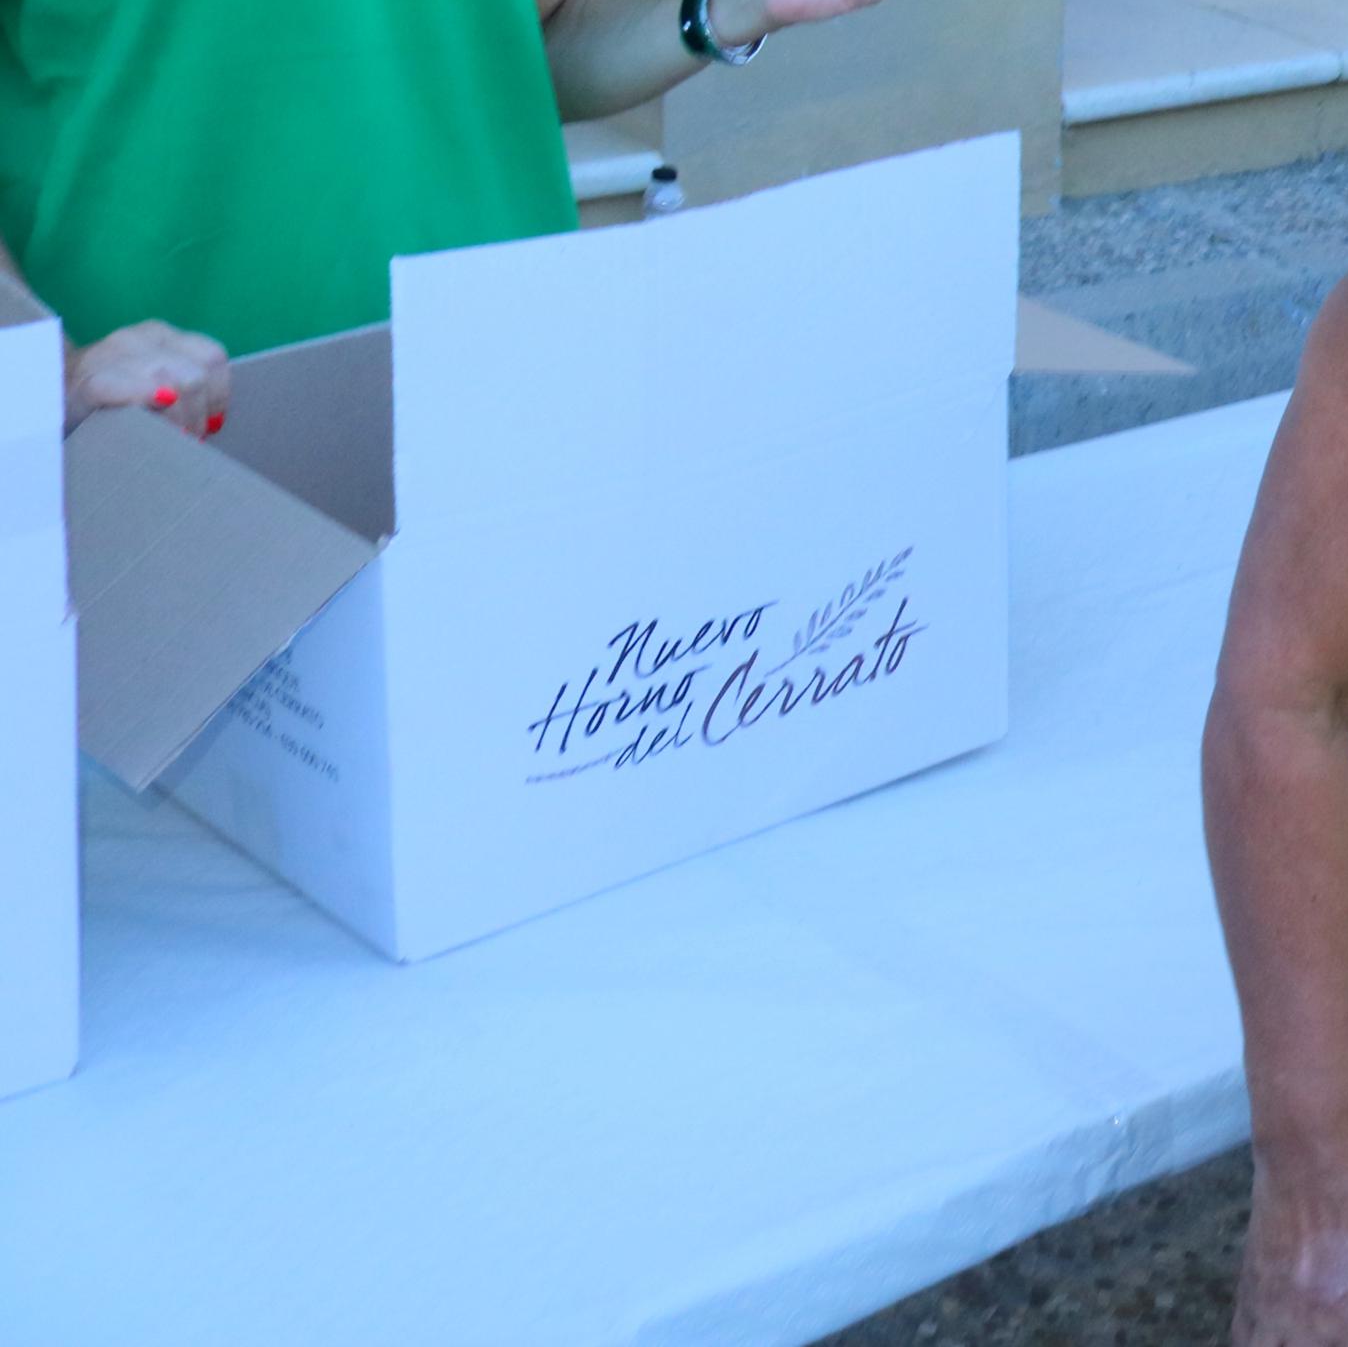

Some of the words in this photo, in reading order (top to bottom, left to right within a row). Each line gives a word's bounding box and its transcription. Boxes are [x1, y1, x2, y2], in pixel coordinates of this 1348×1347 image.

[606, 599, 780, 686] Nuevo
[613, 698, 695, 771] del
[700, 595, 930, 747] Cerrato
[527, 663, 713, 755] Horno
